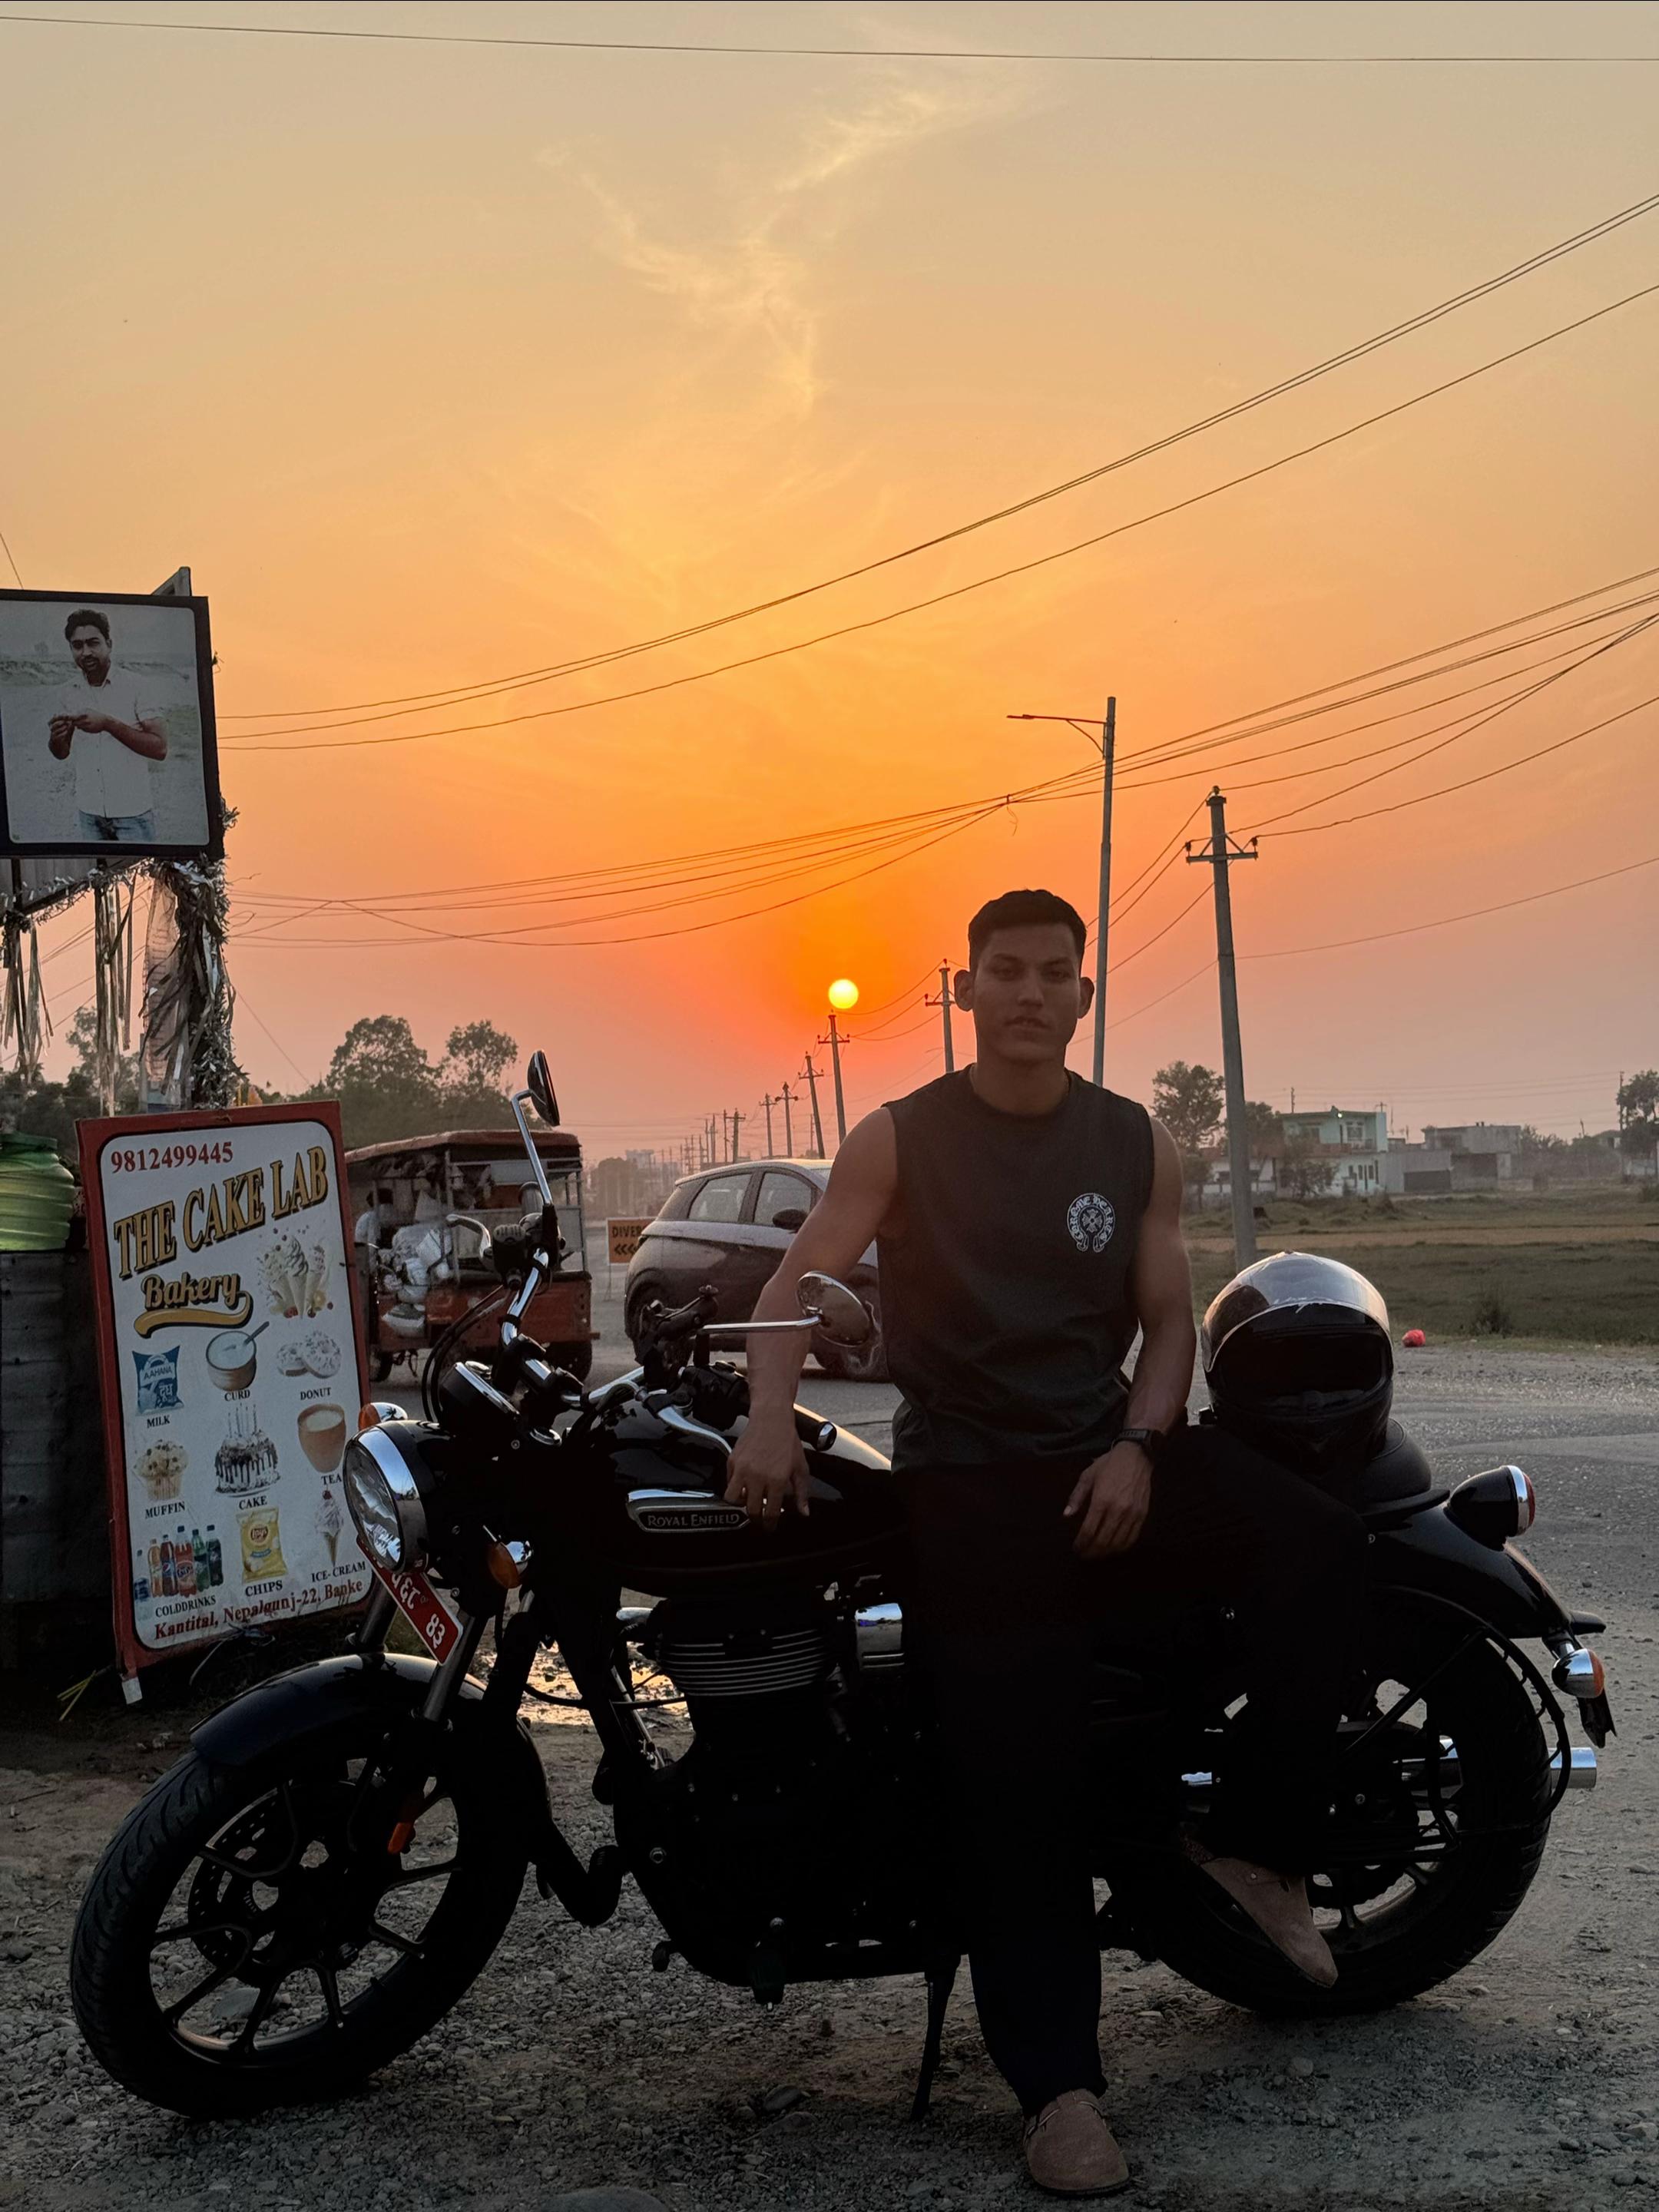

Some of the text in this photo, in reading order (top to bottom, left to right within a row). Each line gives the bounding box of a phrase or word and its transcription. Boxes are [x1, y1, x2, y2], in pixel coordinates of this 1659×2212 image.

[111, 1141, 233, 1174] 9812499445
[114, 1145, 329, 1281] THE CAKE LAB
[141, 1271, 243, 1310] Bakery
[224, 1389, 251, 1402] CURD
[300, 1386, 332, 1401] DONUT
[146, 1415, 171, 1429] MILK
[320, 1472, 343, 1485] TEA
[144, 1501, 186, 1519] MUFFIN
[238, 1495, 268, 1510] CAKE
[647, 1513, 740, 1528] ROYAL ENFIELD
[245, 1580, 283, 1597] CHIPS
[154, 1611, 219, 1640] Kantital,
[324, 1579, 363, 1601] Banke
[155, 1595, 217, 1618] COLDDRINKS
